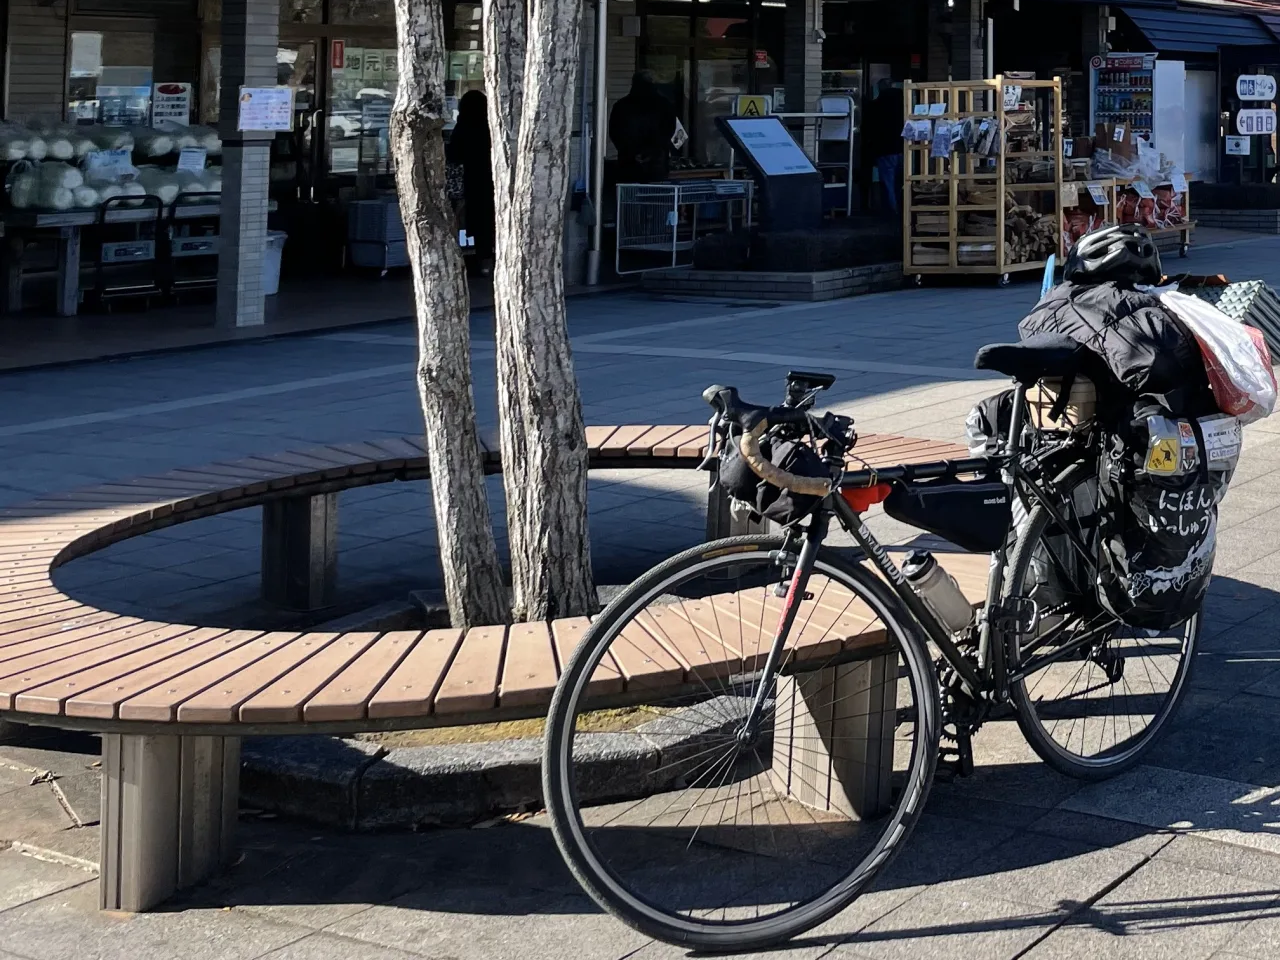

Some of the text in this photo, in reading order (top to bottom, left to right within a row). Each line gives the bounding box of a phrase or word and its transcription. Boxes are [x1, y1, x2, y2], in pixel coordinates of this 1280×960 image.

[1159, 488, 1210, 511] にほん
[1149, 510, 1209, 536] いっしゅう
